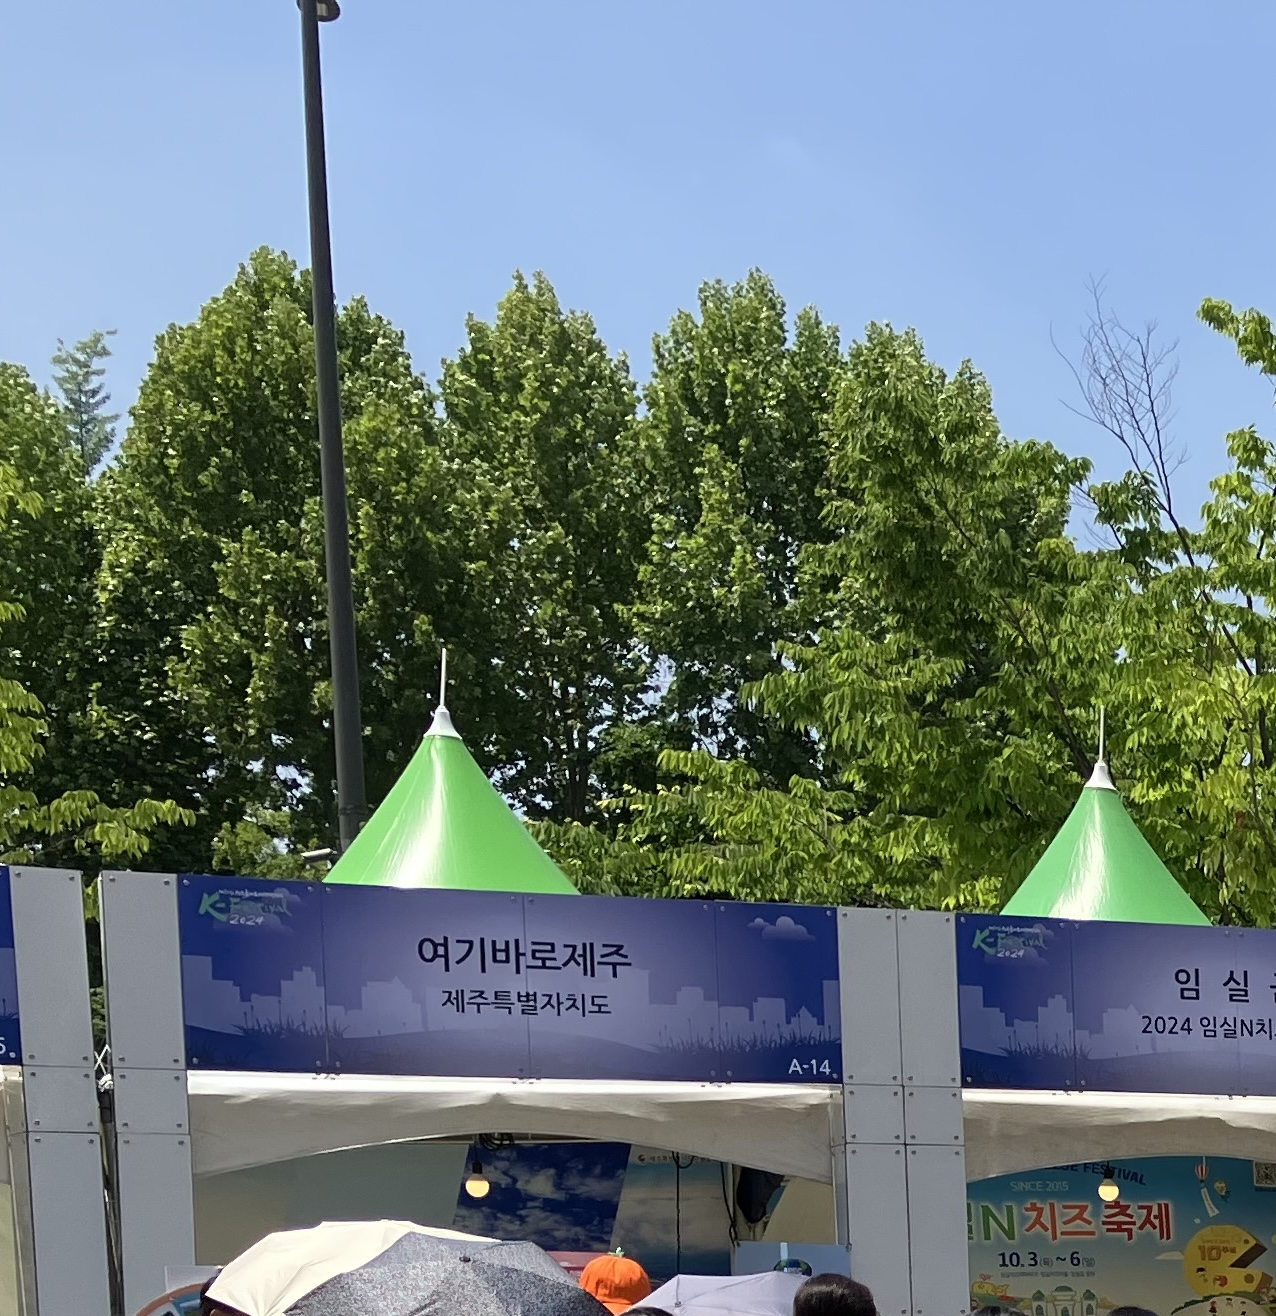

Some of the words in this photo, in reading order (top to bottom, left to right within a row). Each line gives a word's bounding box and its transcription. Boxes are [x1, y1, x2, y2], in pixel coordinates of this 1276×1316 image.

[229, 914, 264, 926] 2024
[417, 935, 633, 979] 여기바로제주
[997, 948, 1025, 958] 2024
[441, 988, 612, 1018] 제주특별자치도
[1141, 1015, 1194, 1036] 2024
[788, 1058, 831, 1076] A-14
[1010, 1180, 1044, 1192] SINCE
[1046, 1180, 1069, 1192] 2015
[1101, 1199, 1172, 1242] 축제
